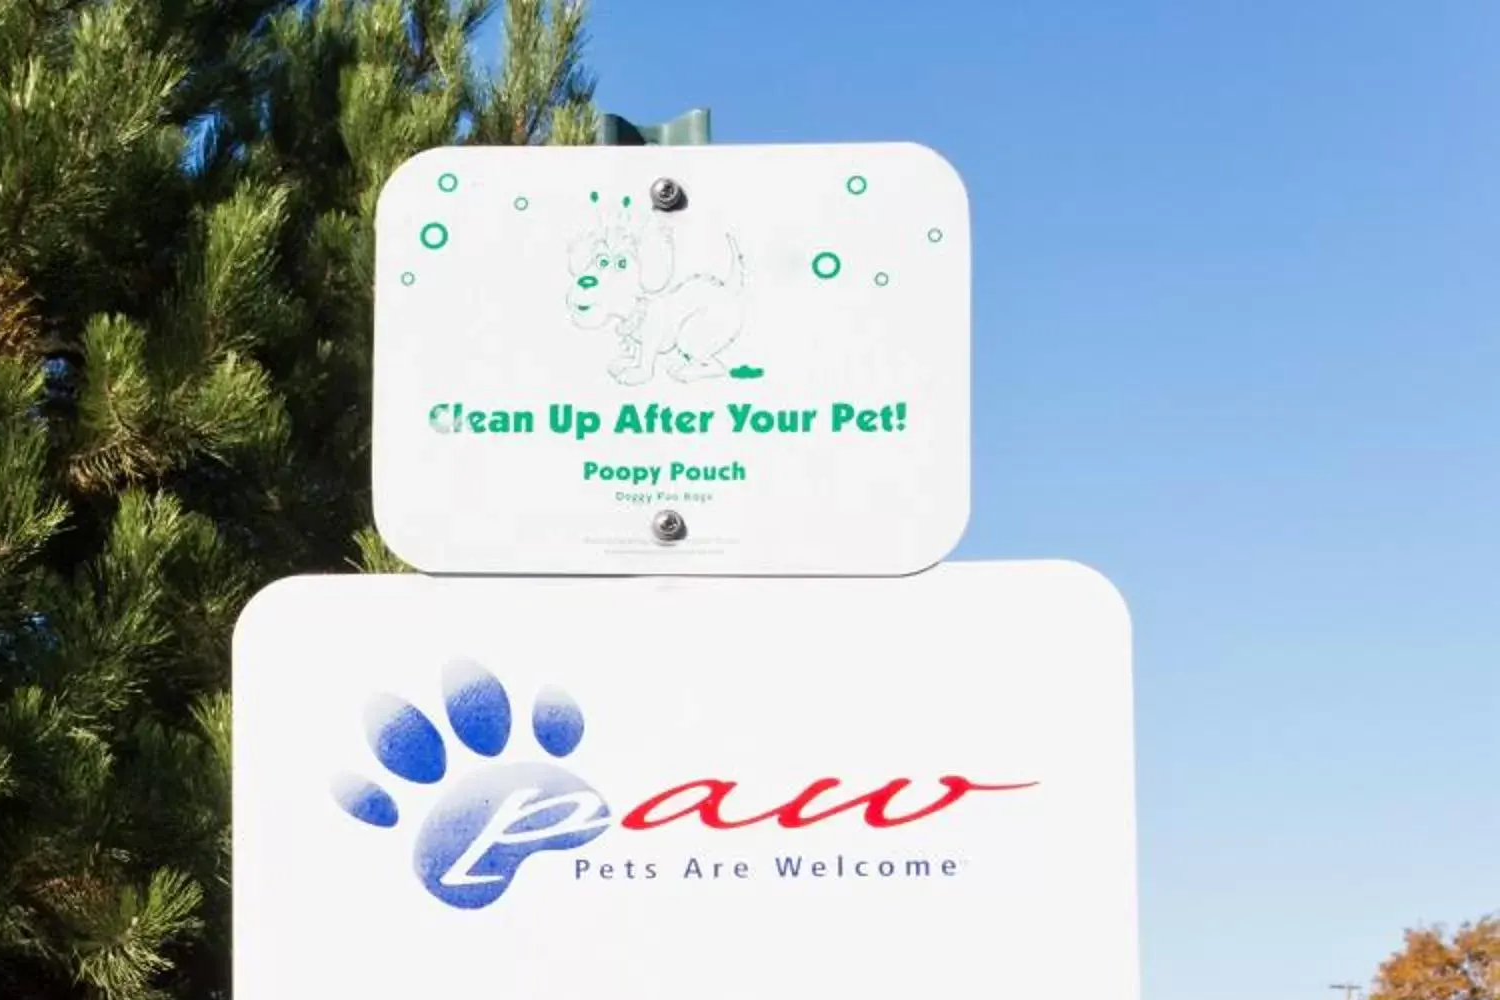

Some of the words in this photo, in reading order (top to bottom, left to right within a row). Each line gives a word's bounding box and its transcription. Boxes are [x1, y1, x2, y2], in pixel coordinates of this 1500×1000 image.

[428, 402, 535, 434] Clean
[548, 403, 601, 441] Up
[613, 402, 714, 435] After
[726, 402, 818, 434] Your
[831, 401, 908, 433] Pet!
[583, 461, 661, 485] Poopy
[670, 460, 746, 481] Pouch
[575, 857, 658, 880] Pets
[684, 857, 750, 880] Are
[775, 856, 958, 879] Welcome
